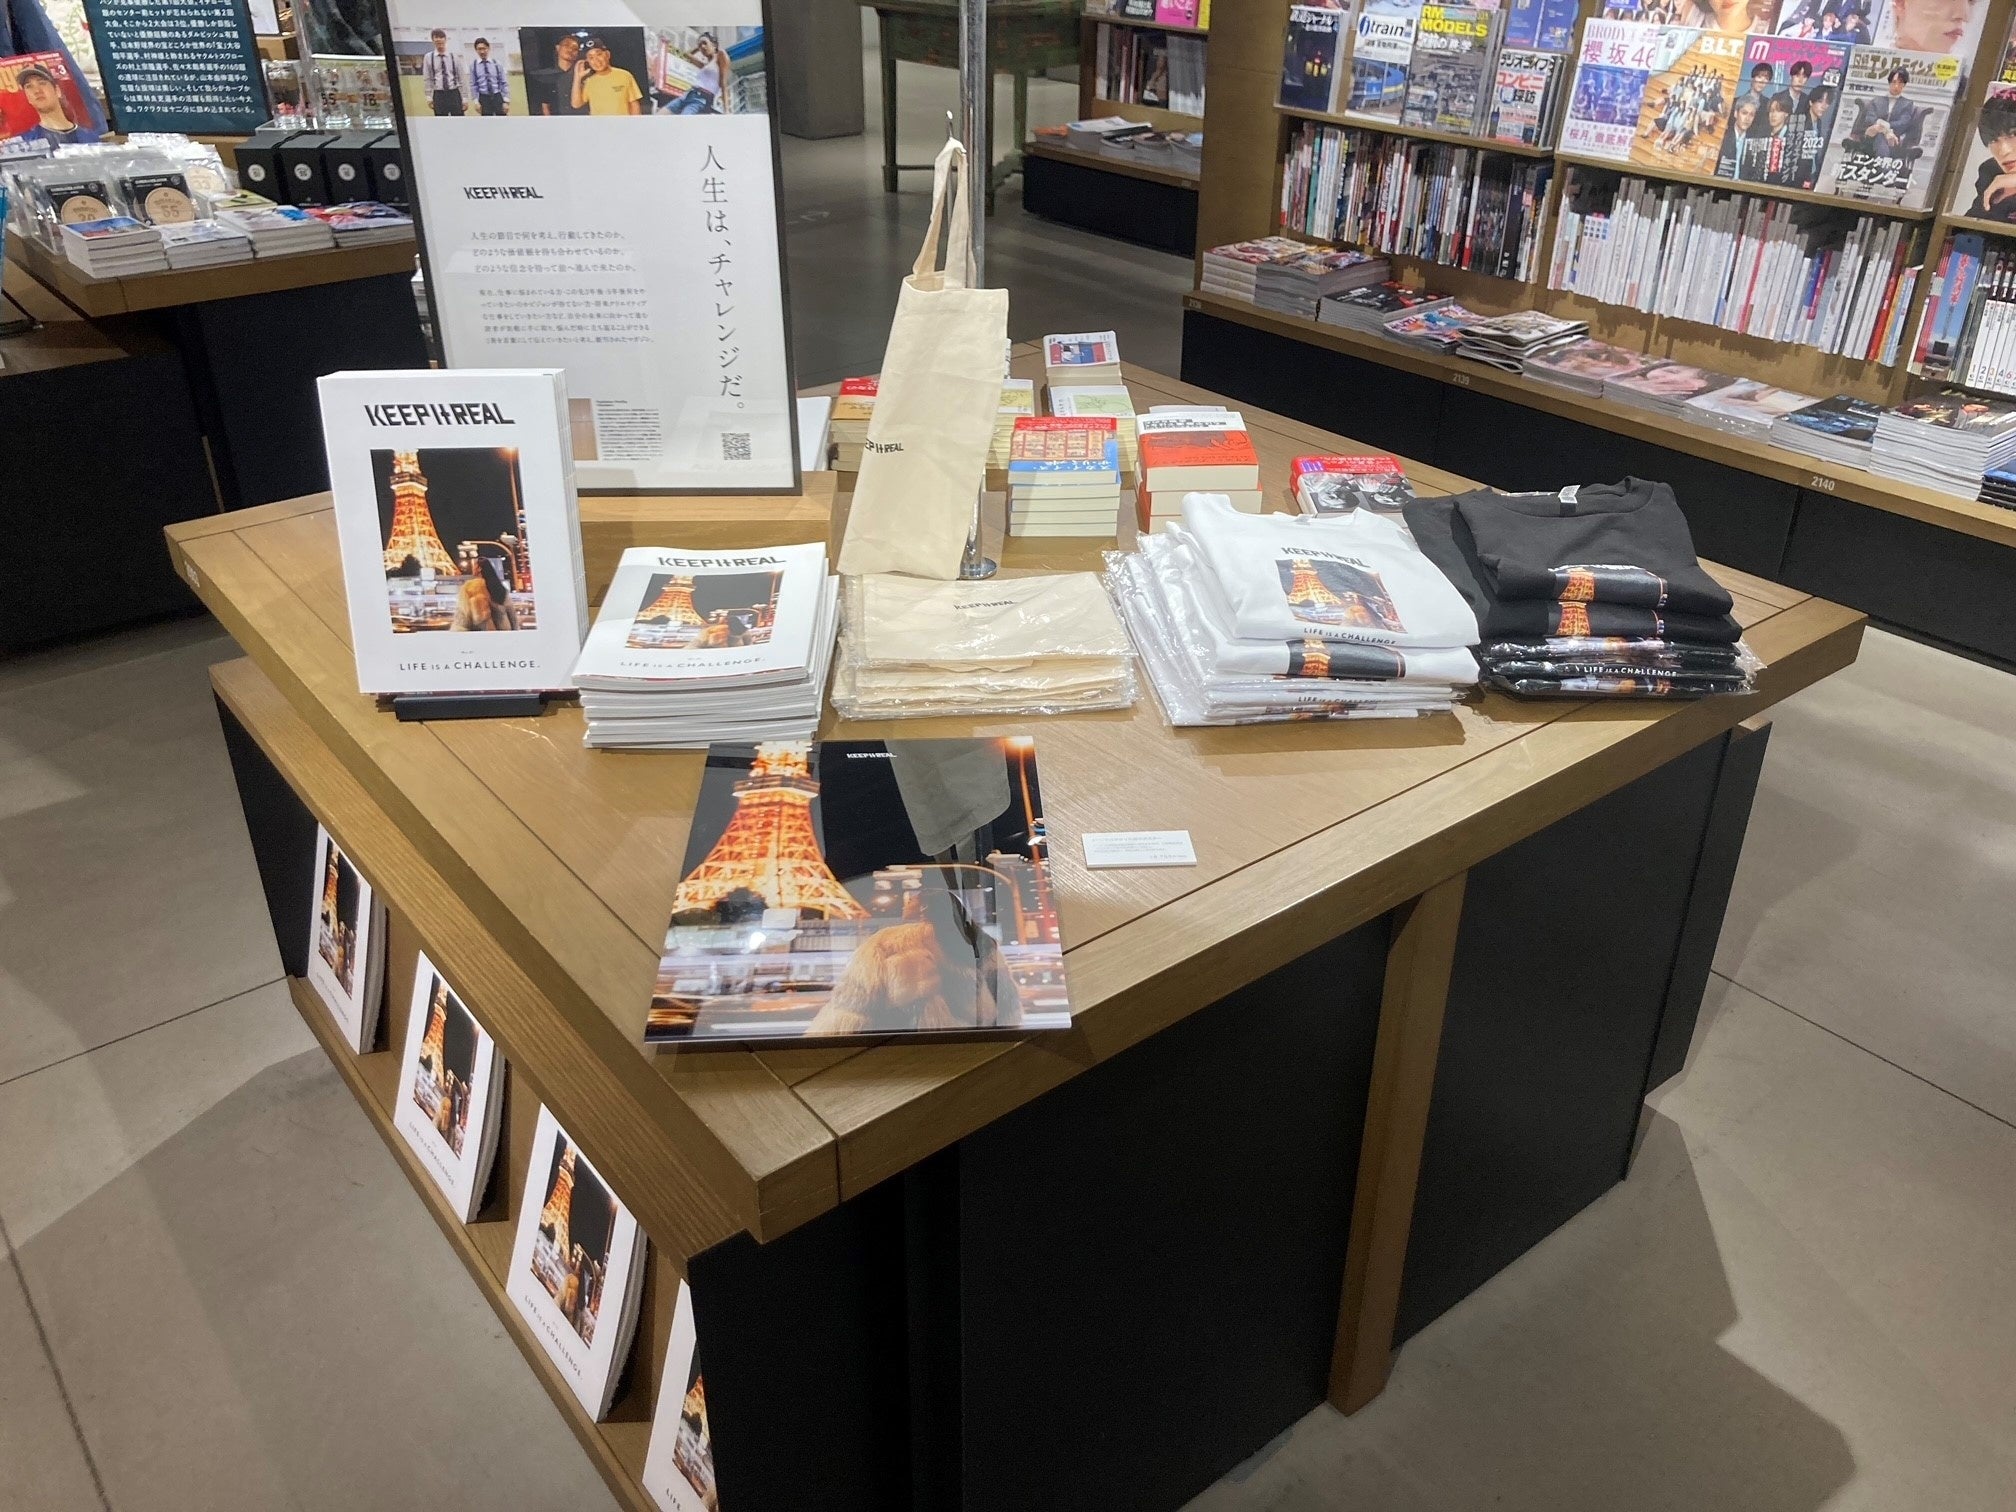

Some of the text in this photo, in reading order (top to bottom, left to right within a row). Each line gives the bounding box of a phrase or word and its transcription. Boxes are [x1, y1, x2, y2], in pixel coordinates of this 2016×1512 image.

[1371, 20, 1404, 37] train
[1421, 18, 1488, 37] MODELS
[1497, 72, 1544, 90] コンビニ
[1802, 137, 1824, 149] 2023
[700, 144, 745, 409] 人生は、チャレンジだ。
[1811, 475, 1835, 491] 2140
[1303, 627, 1323, 636] LIFE
[400, 663, 427, 671] LIFE
